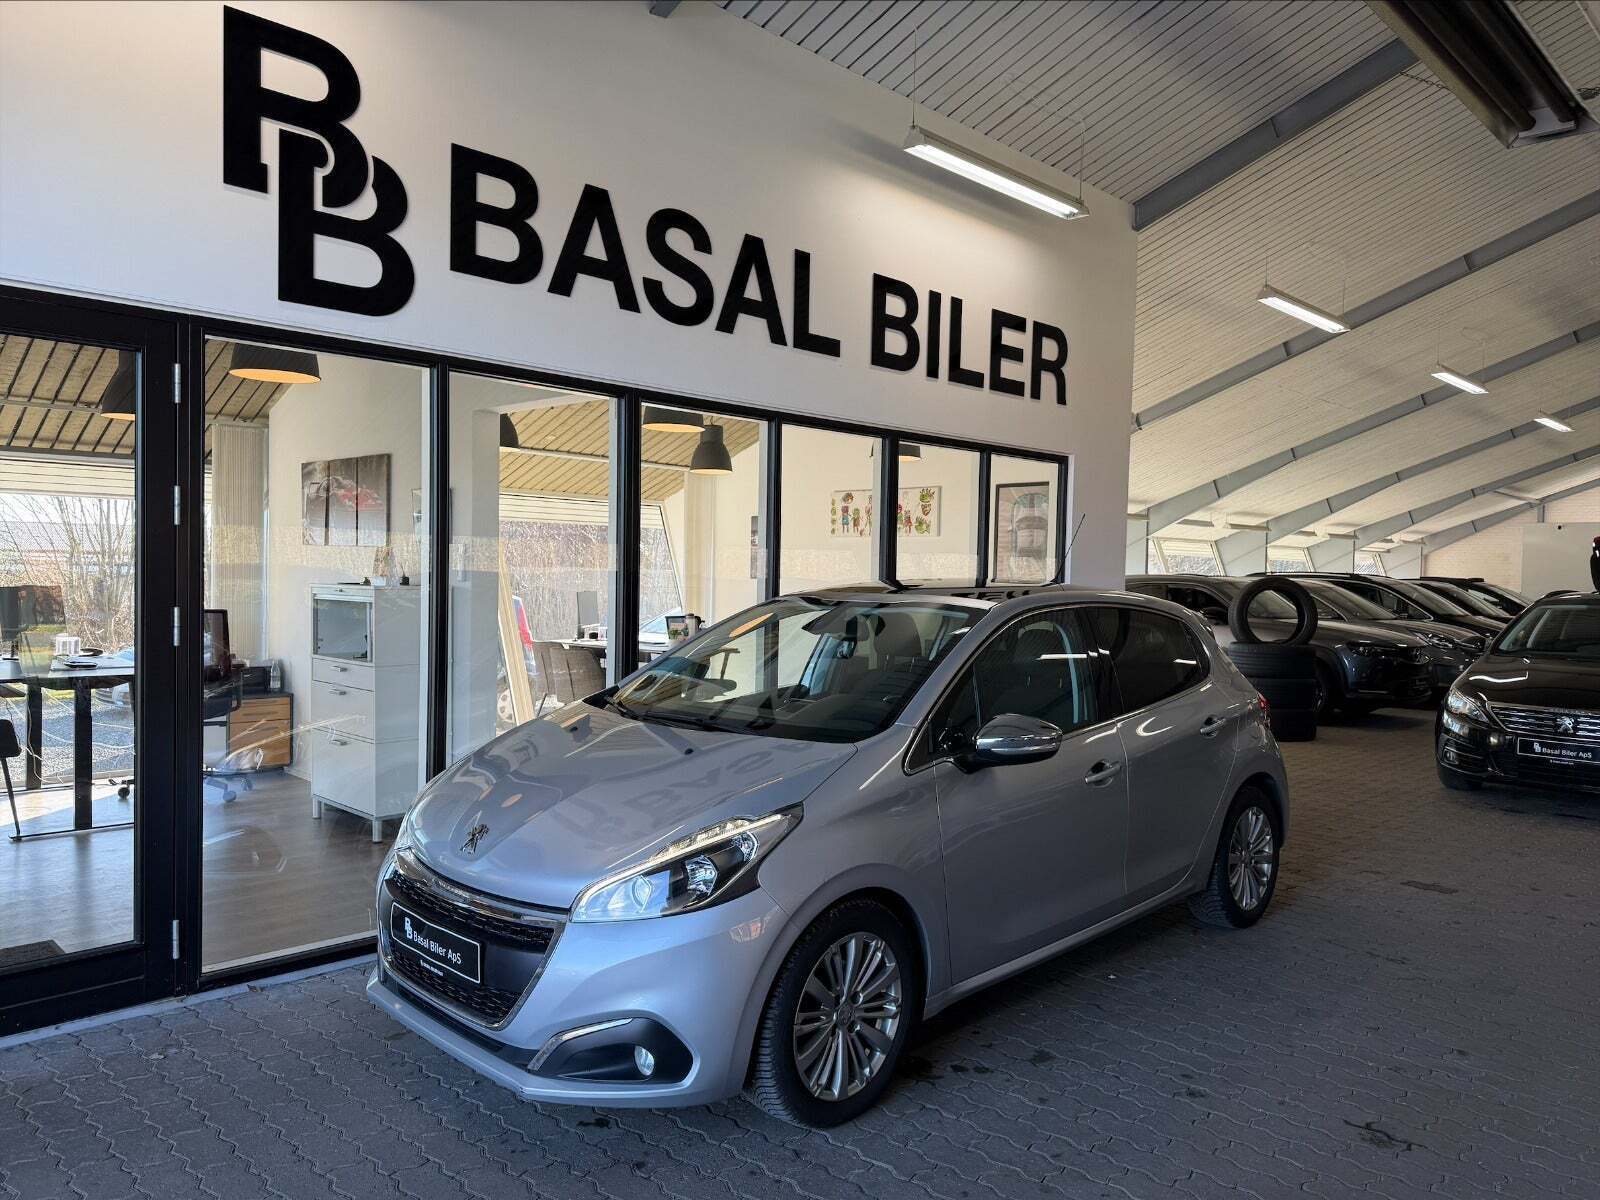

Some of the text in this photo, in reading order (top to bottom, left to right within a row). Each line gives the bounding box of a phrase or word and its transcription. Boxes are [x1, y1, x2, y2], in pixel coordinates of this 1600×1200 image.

[450, 143, 1068, 405] BASAL BILER
[1578, 751, 1592, 759] ApS
[413, 930, 429, 949] Basal
[429, 941, 446, 956] Biler
[447, 949, 462, 965] ApS
